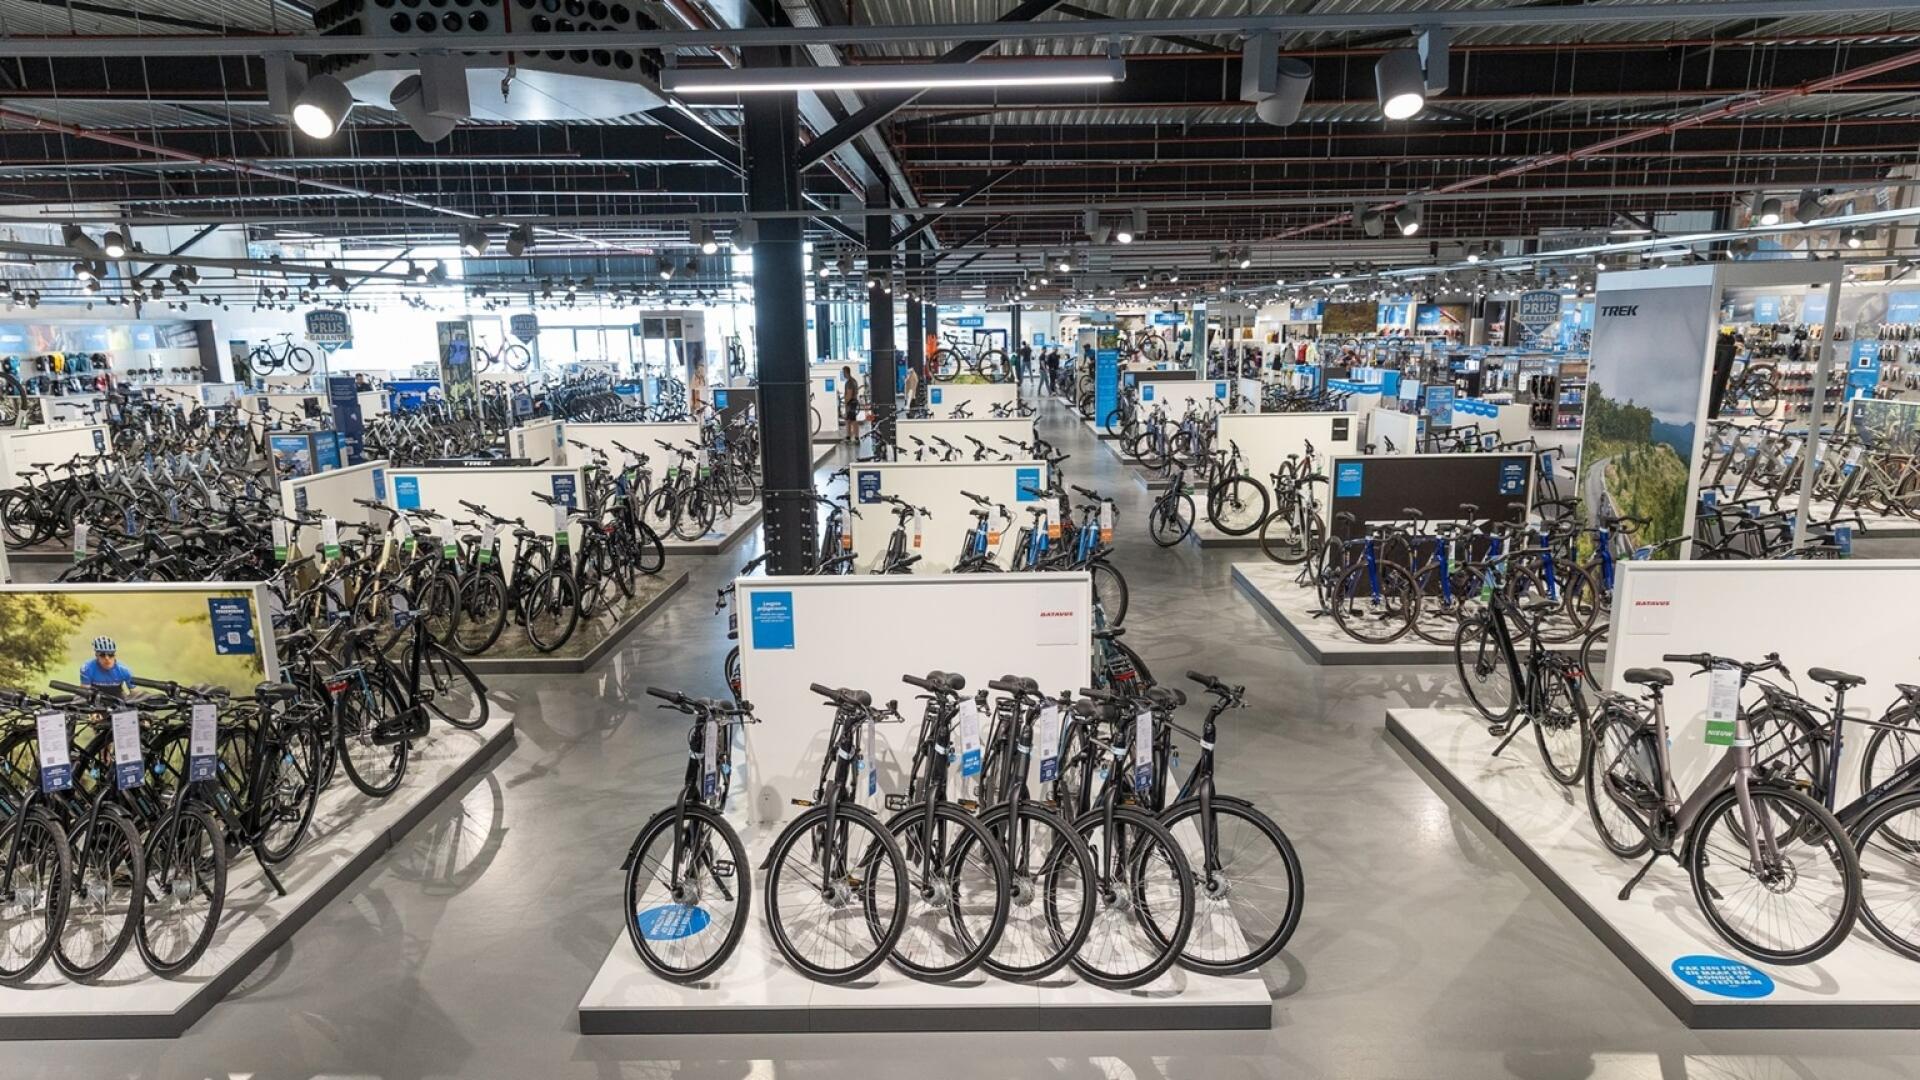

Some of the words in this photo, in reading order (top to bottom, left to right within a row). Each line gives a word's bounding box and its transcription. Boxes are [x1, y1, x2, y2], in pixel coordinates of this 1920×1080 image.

[1523, 294, 1557, 302] LAAGSTE
[1523, 303, 1556, 313] PRIJS
[1600, 305, 1639, 316] TREK
[311, 322, 345, 332] PRIJS
